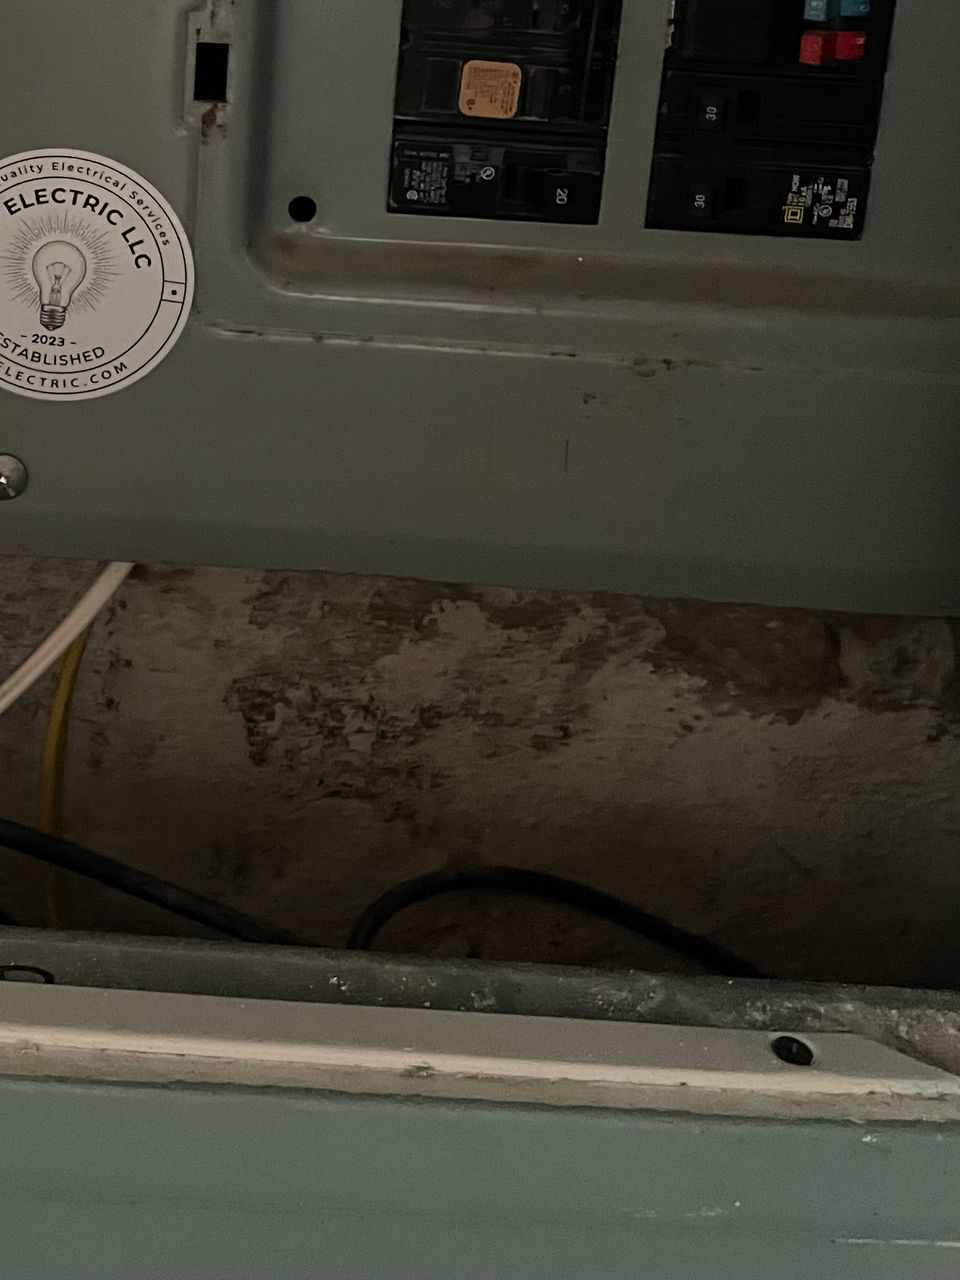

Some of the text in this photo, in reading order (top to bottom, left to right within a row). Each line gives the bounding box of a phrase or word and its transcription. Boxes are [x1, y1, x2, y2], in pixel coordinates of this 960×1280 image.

[706, 106, 718, 121] 30
[51, 161, 127, 192] Electrical
[129, 190, 170, 246] Services
[555, 188, 568, 204] 20
[694, 194, 706, 209] 30
[3, 187, 124, 226] ELECTRIC
[121, 226, 152, 269] LLC
[31, 333, 65, 347] 2023
